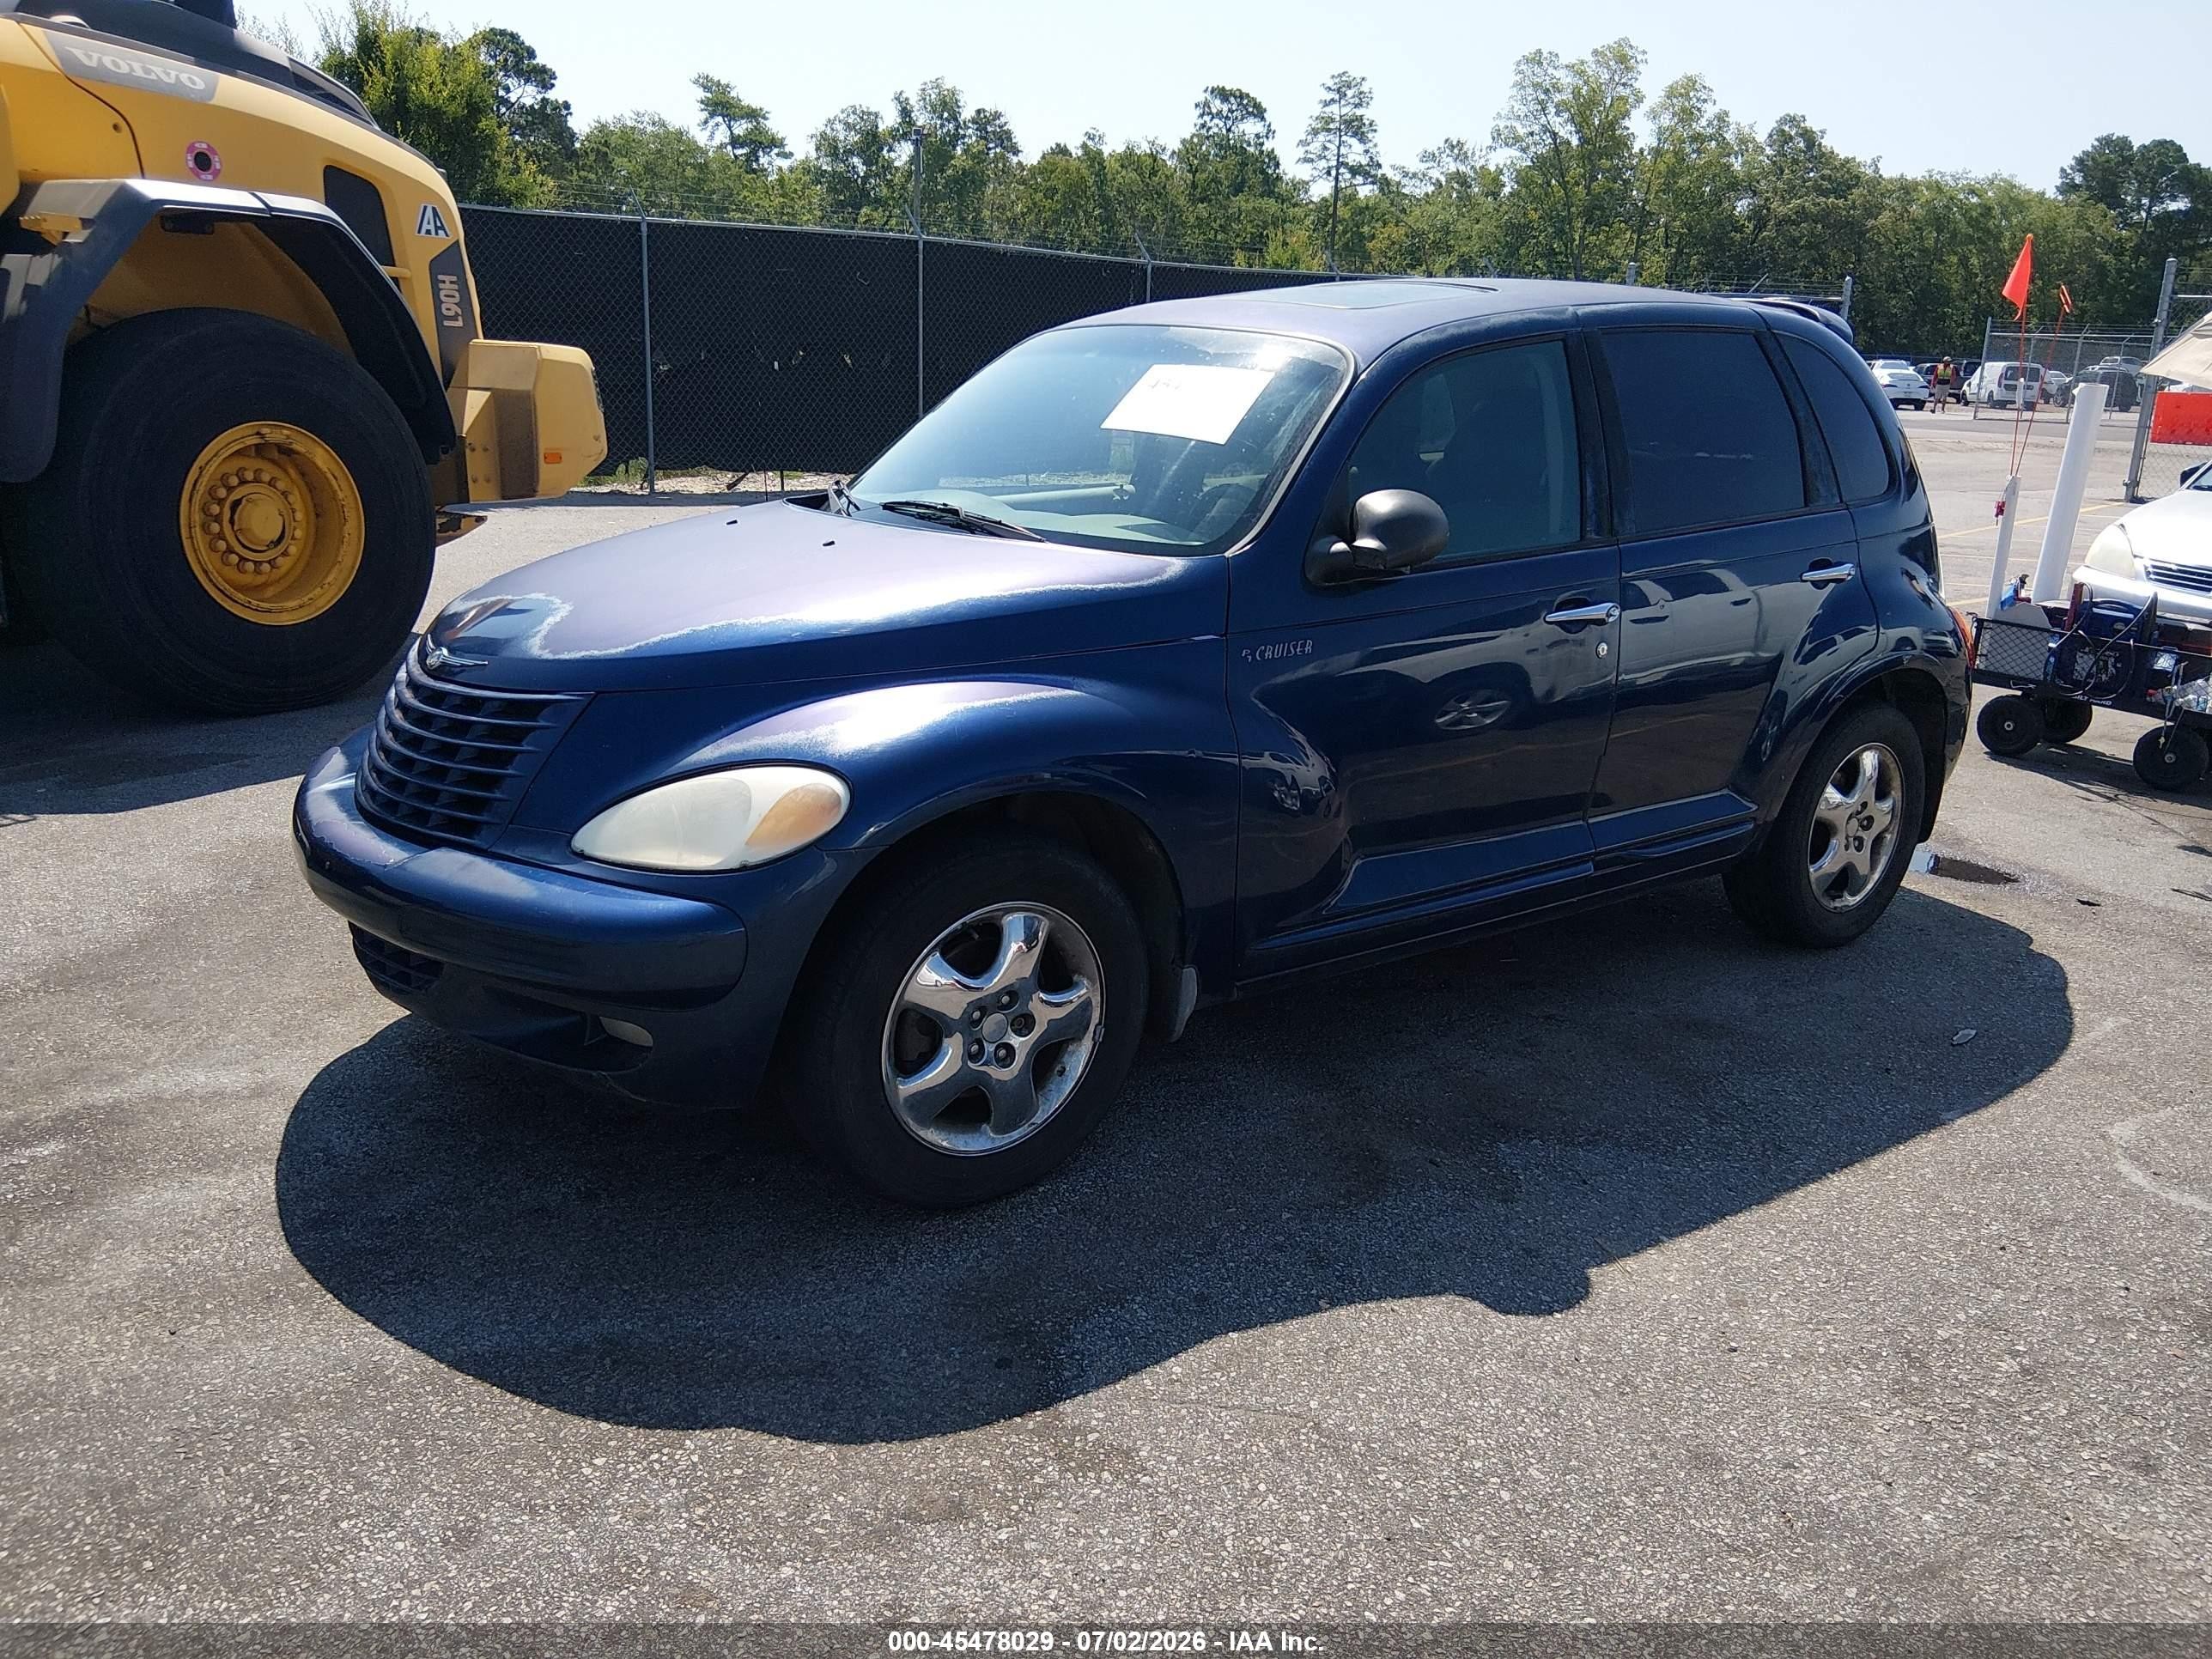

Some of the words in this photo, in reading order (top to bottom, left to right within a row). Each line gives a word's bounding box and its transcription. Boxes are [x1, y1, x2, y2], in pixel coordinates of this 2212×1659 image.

[64, 46, 206, 90] VOLVO
[437, 274, 465, 328] L90H
[1255, 639, 1314, 660] CRUISER
